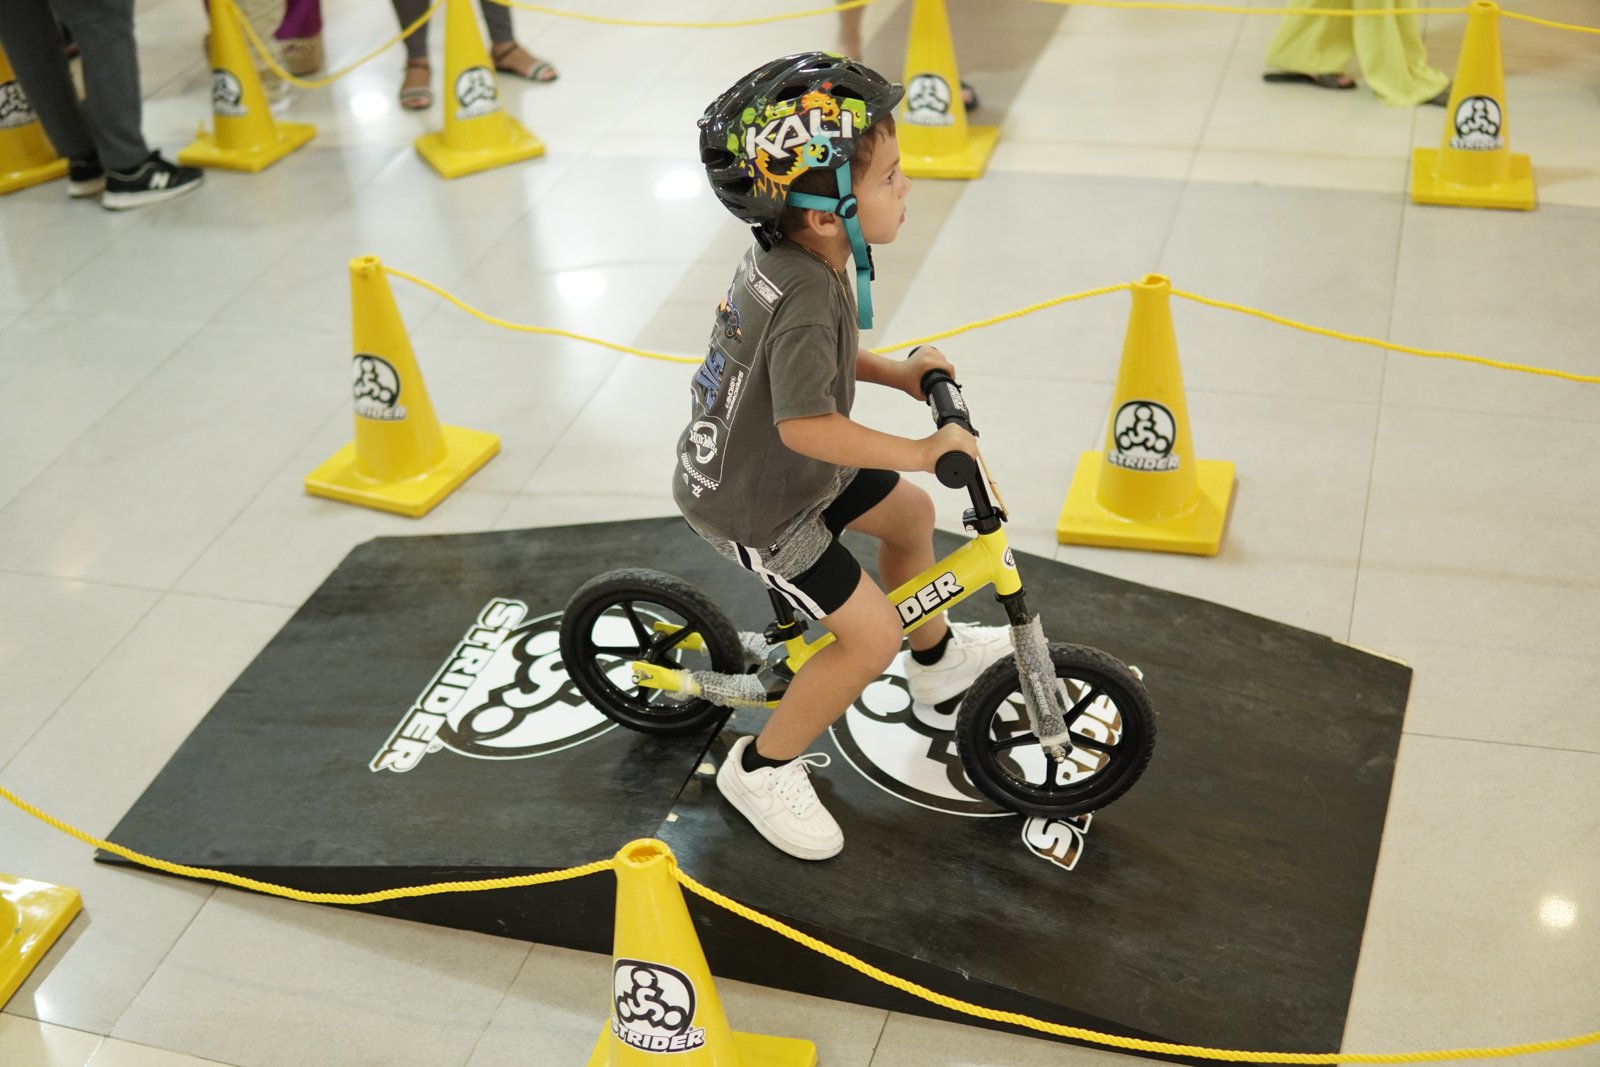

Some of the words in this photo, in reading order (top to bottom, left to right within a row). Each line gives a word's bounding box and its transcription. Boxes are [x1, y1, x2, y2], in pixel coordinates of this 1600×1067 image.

[745, 108, 853, 160] KALI
[895, 571, 965, 630] DER
[369, 597, 529, 773] STRIDER
[611, 1014, 706, 1054] STRIDER
